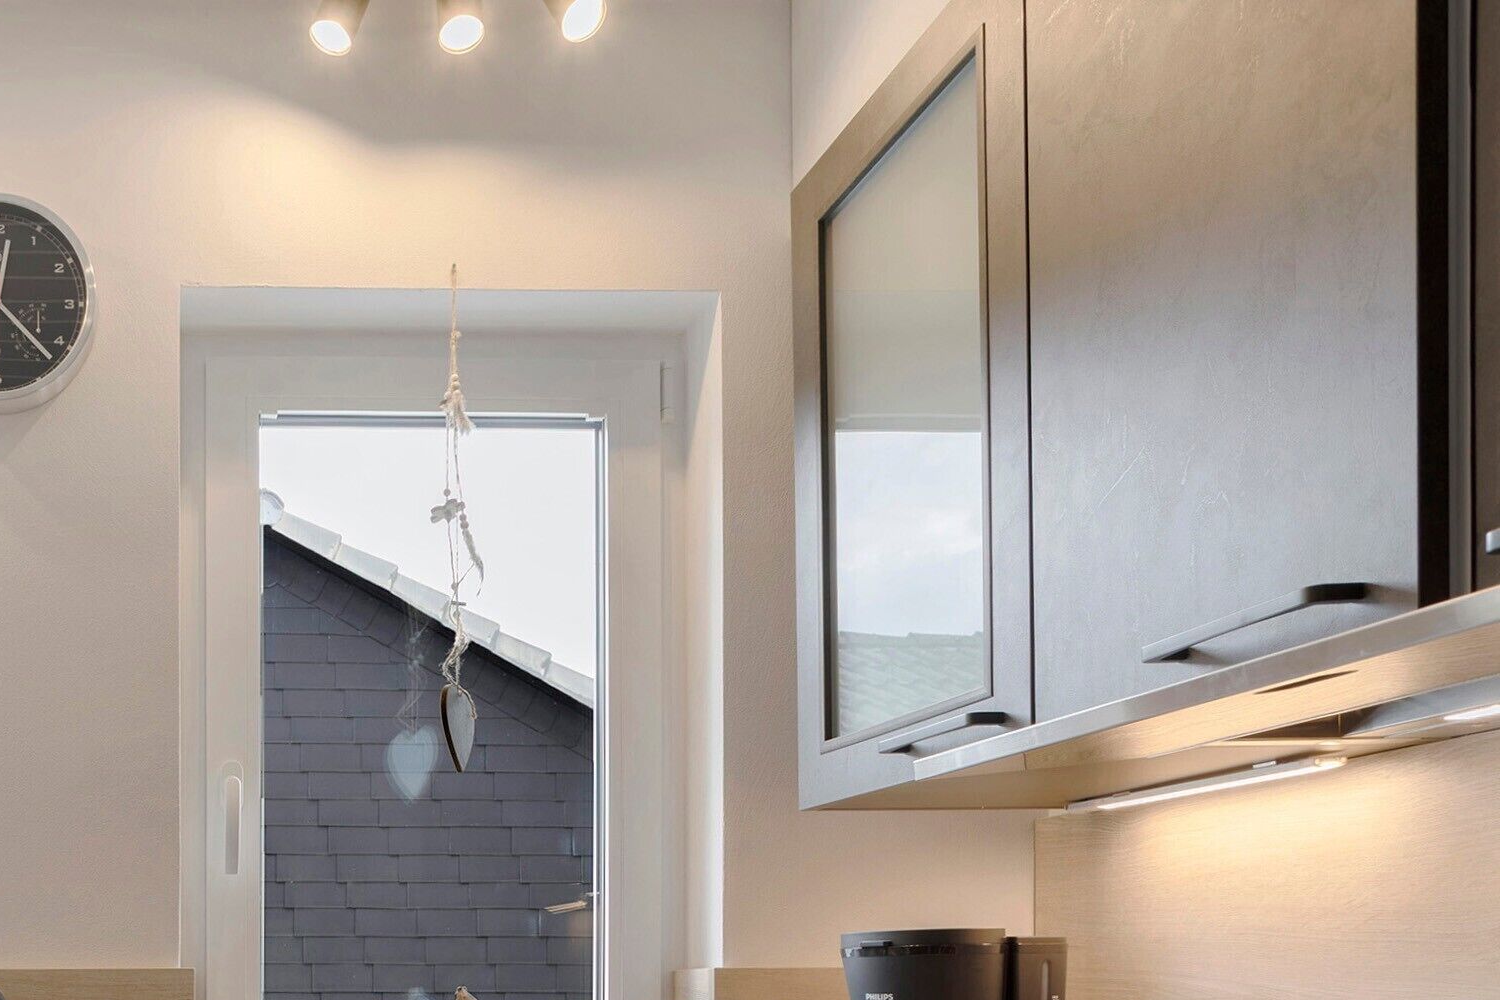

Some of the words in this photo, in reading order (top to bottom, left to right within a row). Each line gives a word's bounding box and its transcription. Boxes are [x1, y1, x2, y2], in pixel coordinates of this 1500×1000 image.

[31, 236, 36, 245] 1
[54, 263, 64, 273] 2
[64, 299, 75, 309] 3
[53, 335, 65, 345] 4
[865, 993, 894, 1000] PHILIPS
